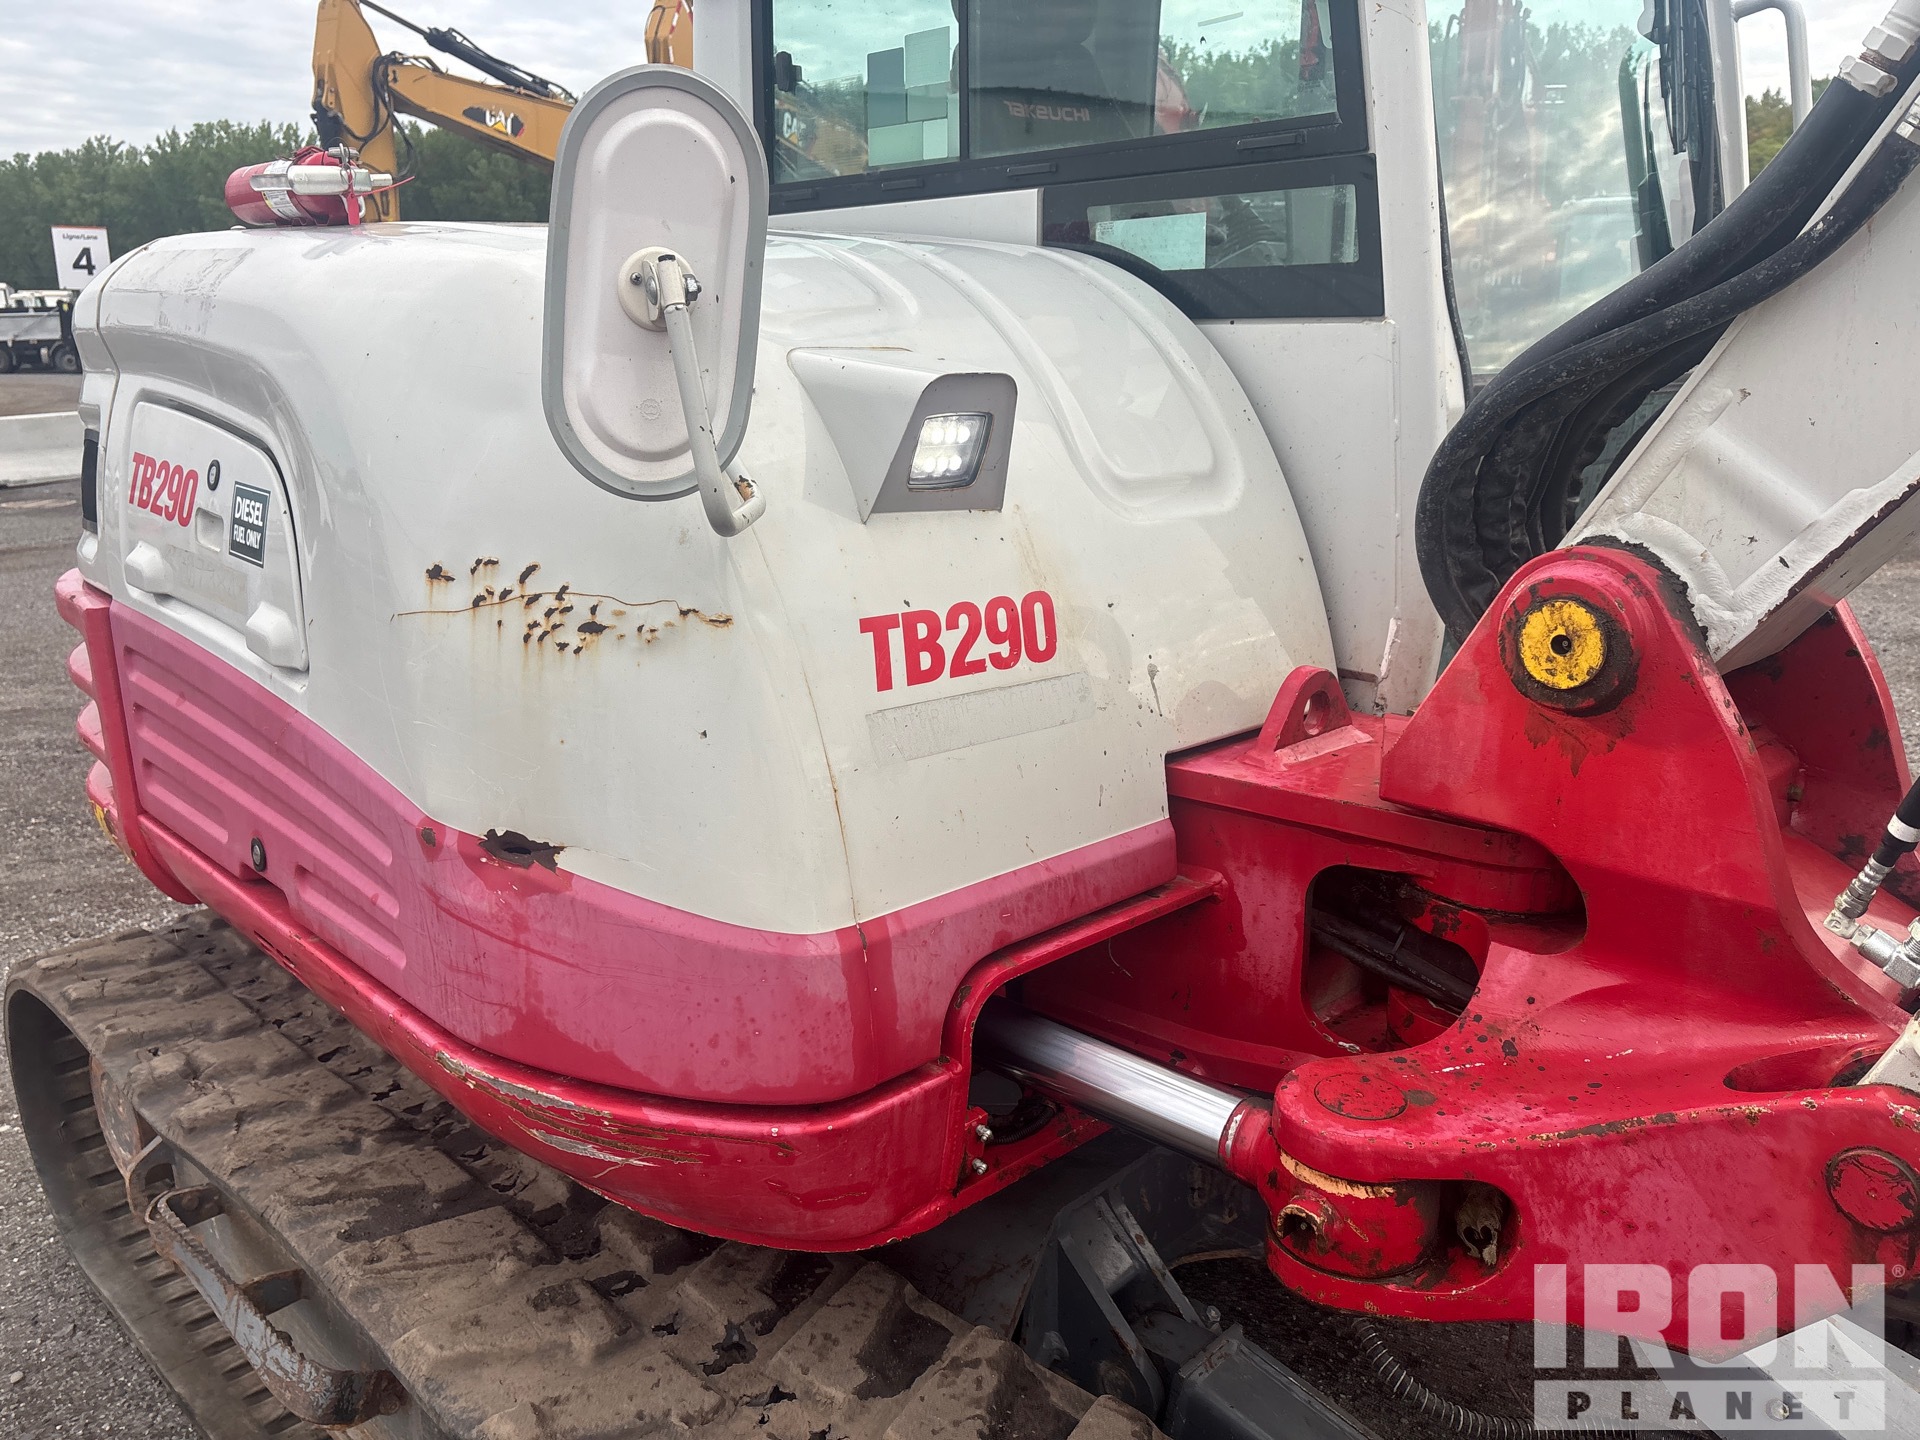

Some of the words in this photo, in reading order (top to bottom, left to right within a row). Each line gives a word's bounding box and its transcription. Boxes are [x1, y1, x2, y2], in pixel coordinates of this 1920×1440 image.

[62, 232, 98, 241] Ligne/Lane
[73, 247, 96, 276] 4
[129, 451, 199, 527] TB290
[234, 496, 263, 526] DIESEL
[233, 525, 246, 546] FUEL
[246, 528, 262, 550] ONLY
[859, 590, 1057, 692] TB290
